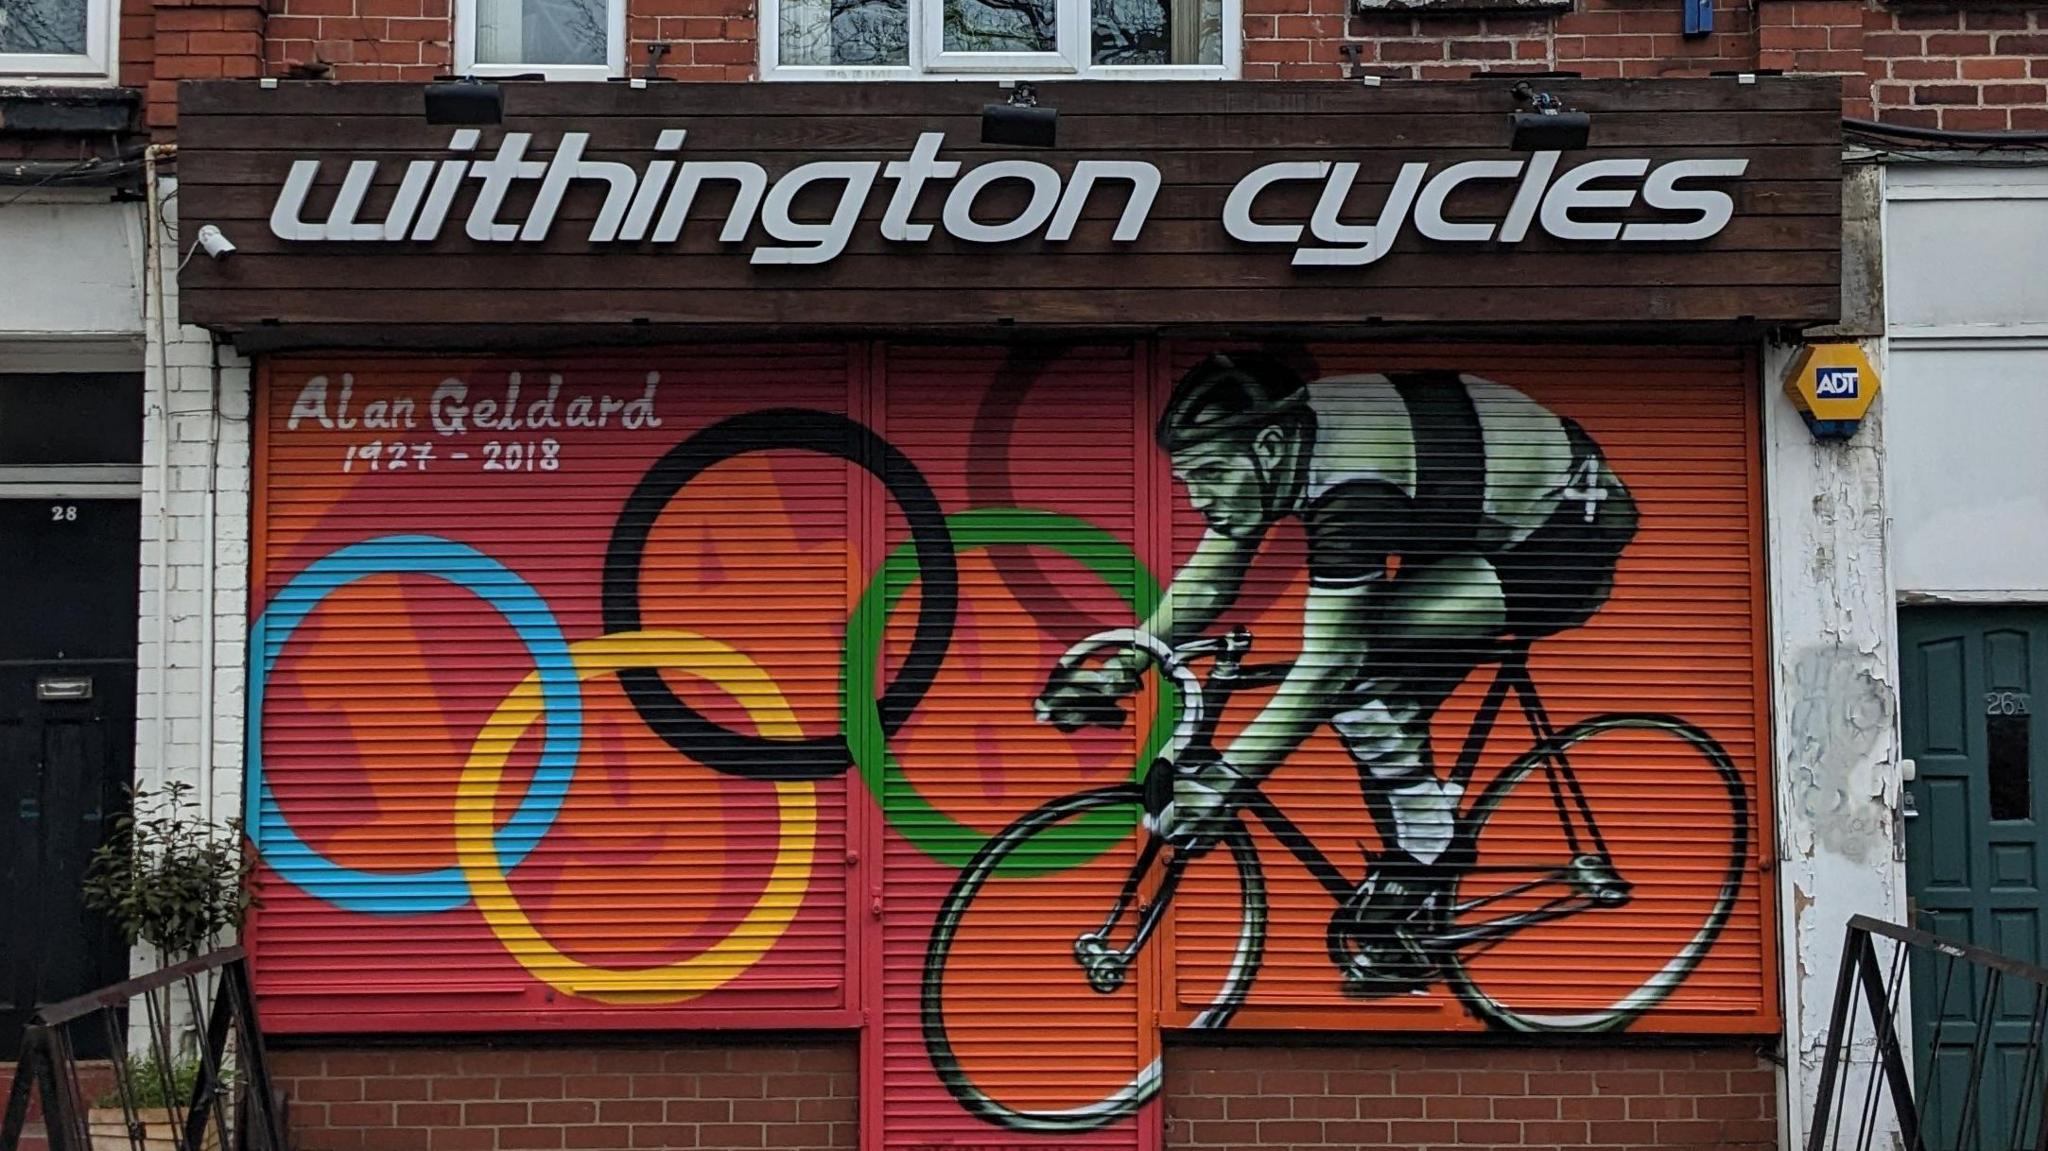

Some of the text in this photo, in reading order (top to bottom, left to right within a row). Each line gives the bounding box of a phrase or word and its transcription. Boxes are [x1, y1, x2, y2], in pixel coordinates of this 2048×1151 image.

[269, 129, 1749, 267] withington cycles
[1815, 372, 1859, 394] ADT
[287, 370, 663, 436] Alan Geldard
[342, 440, 438, 473] 1927
[482, 437, 561, 472] 2018
[1564, 454, 1609, 523] 4
[51, 506, 77, 521] 28
[1986, 691, 2030, 716] 26A
